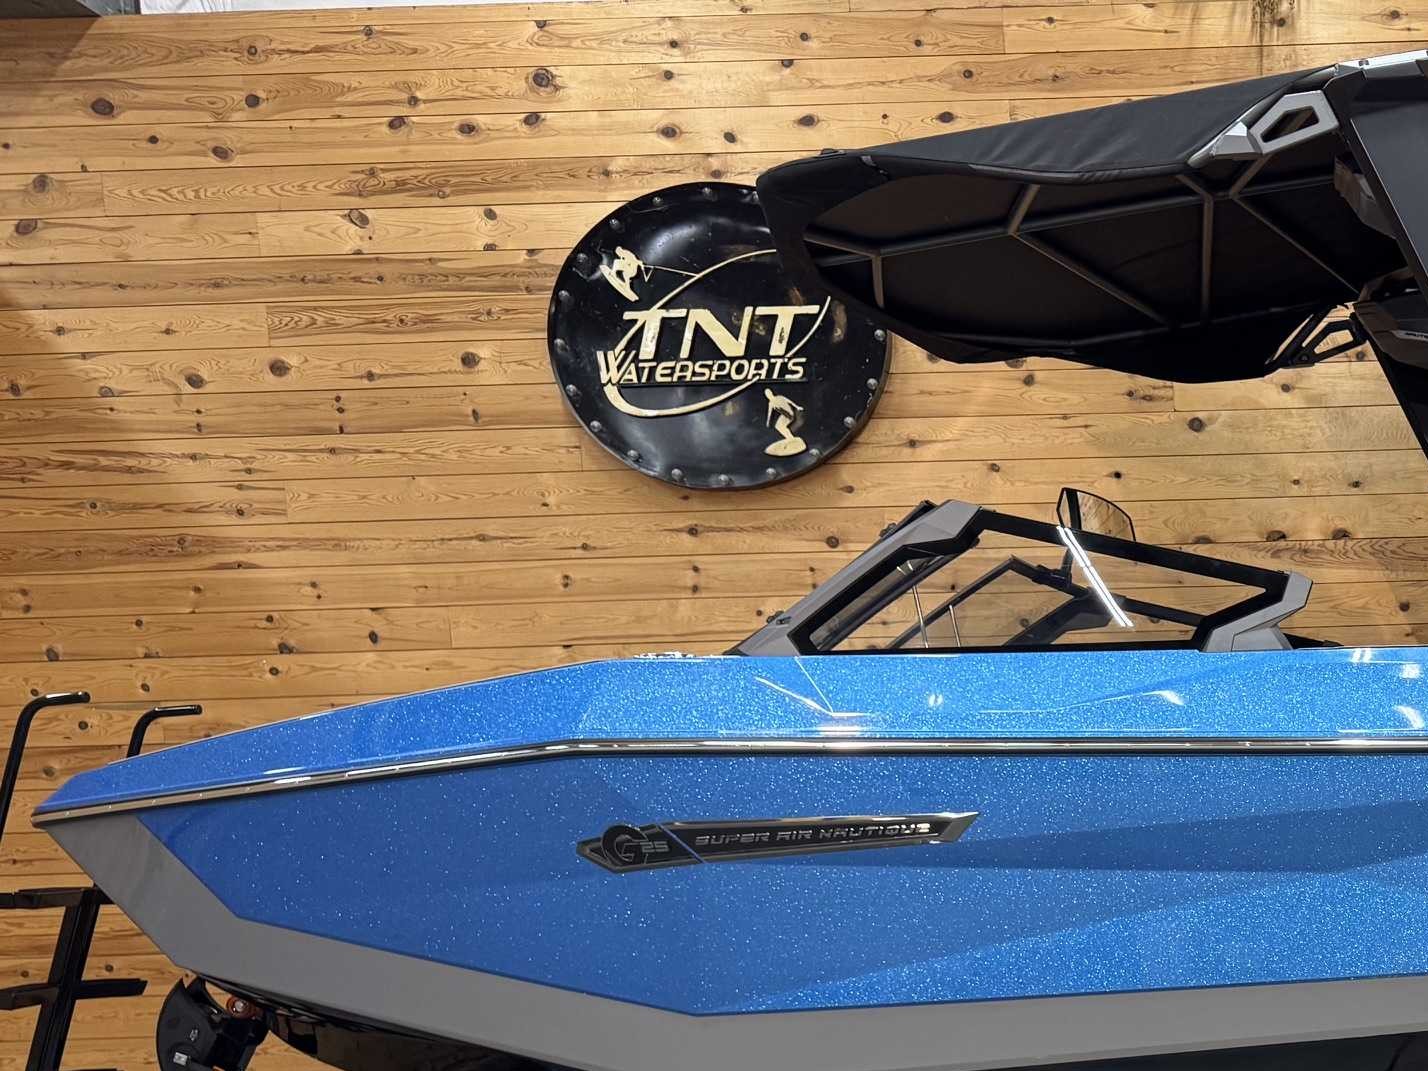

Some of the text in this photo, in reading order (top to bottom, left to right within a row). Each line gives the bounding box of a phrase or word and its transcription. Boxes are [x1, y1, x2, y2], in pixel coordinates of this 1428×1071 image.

[622, 305, 820, 360] TNT
[596, 350, 808, 385] WATERSPORTS
[694, 823, 931, 846] SUPER AIR NAUTIQUE
